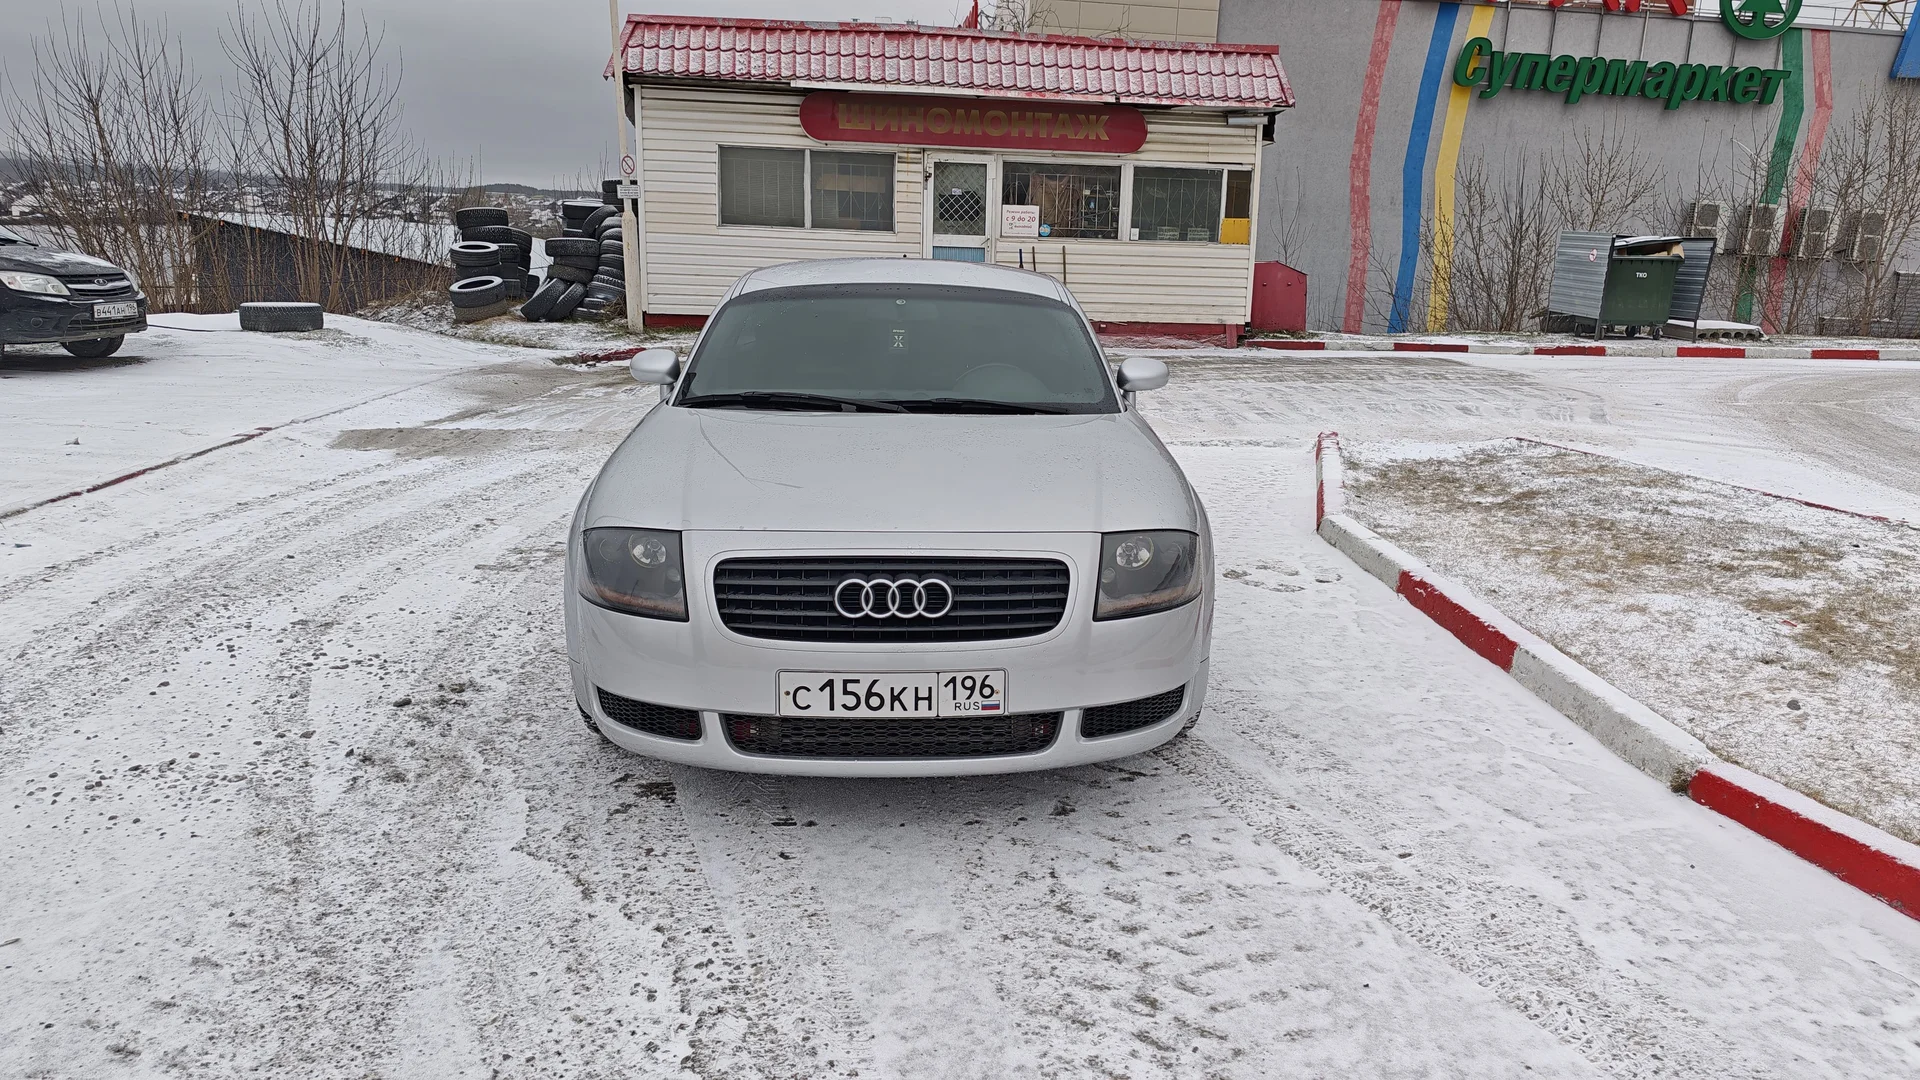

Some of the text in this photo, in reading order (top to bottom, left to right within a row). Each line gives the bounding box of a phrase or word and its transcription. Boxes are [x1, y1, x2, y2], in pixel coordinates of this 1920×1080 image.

[1452, 36, 1792, 109] Супермаркет
[838, 103, 1110, 141] ШИНОМОНТАЖ
[943, 675, 995, 701] 196
[954, 701, 981, 712] RUS
